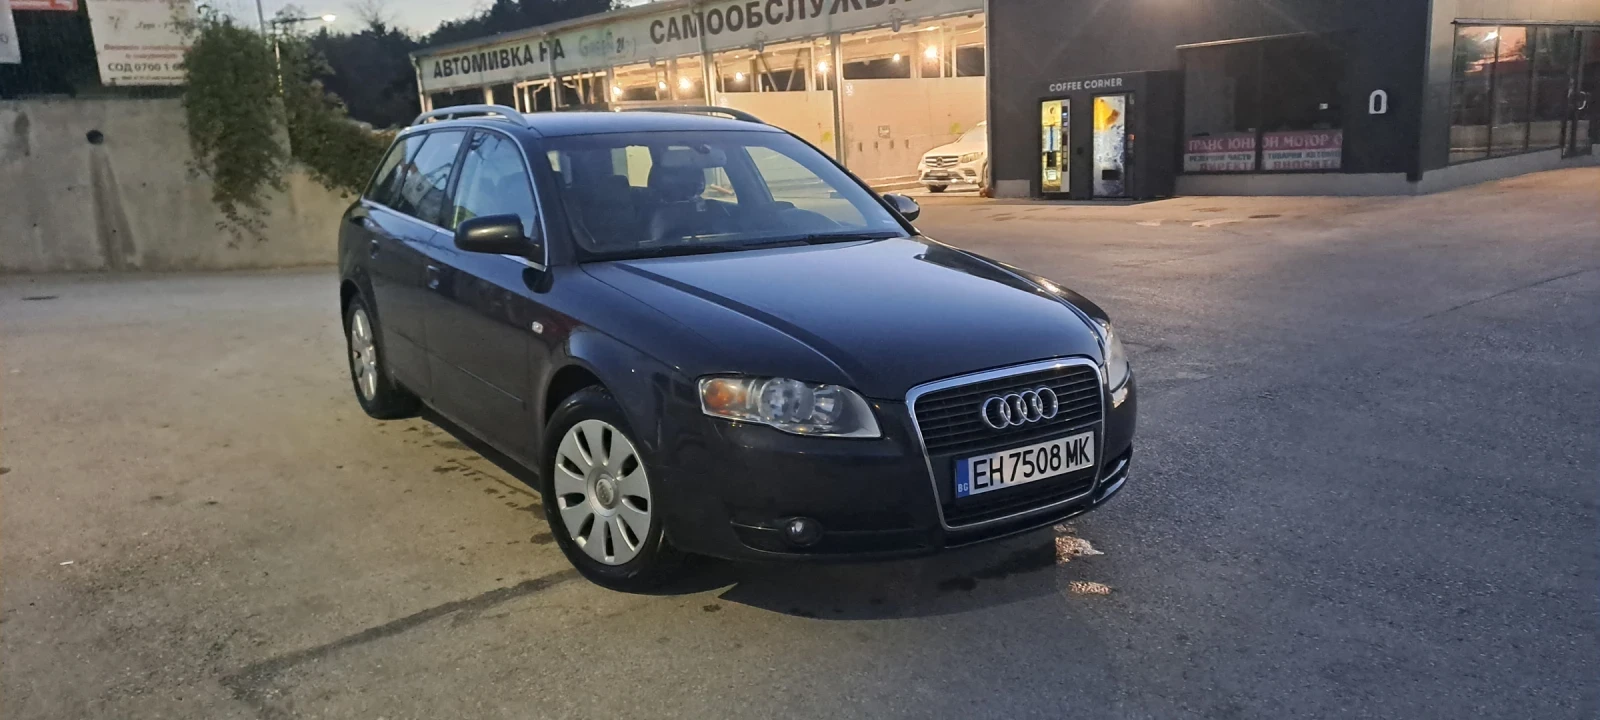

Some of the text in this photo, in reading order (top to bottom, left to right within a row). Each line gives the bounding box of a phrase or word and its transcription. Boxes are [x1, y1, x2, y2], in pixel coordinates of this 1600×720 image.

[650, 0, 910, 44] САМООБСЛУЖ
[107, 62, 133, 73] СОД
[134, 62, 159, 72] 0700
[433, 45, 534, 79] АВТОМИВКА
[1049, 78, 1123, 92] COFFEE CORNER
[1188, 138, 1223, 152] ТРАНС
[1283, 134, 1329, 148] МОТОР
[973, 436, 1091, 490] EH 7508 MK
[957, 483, 969, 493] BG
